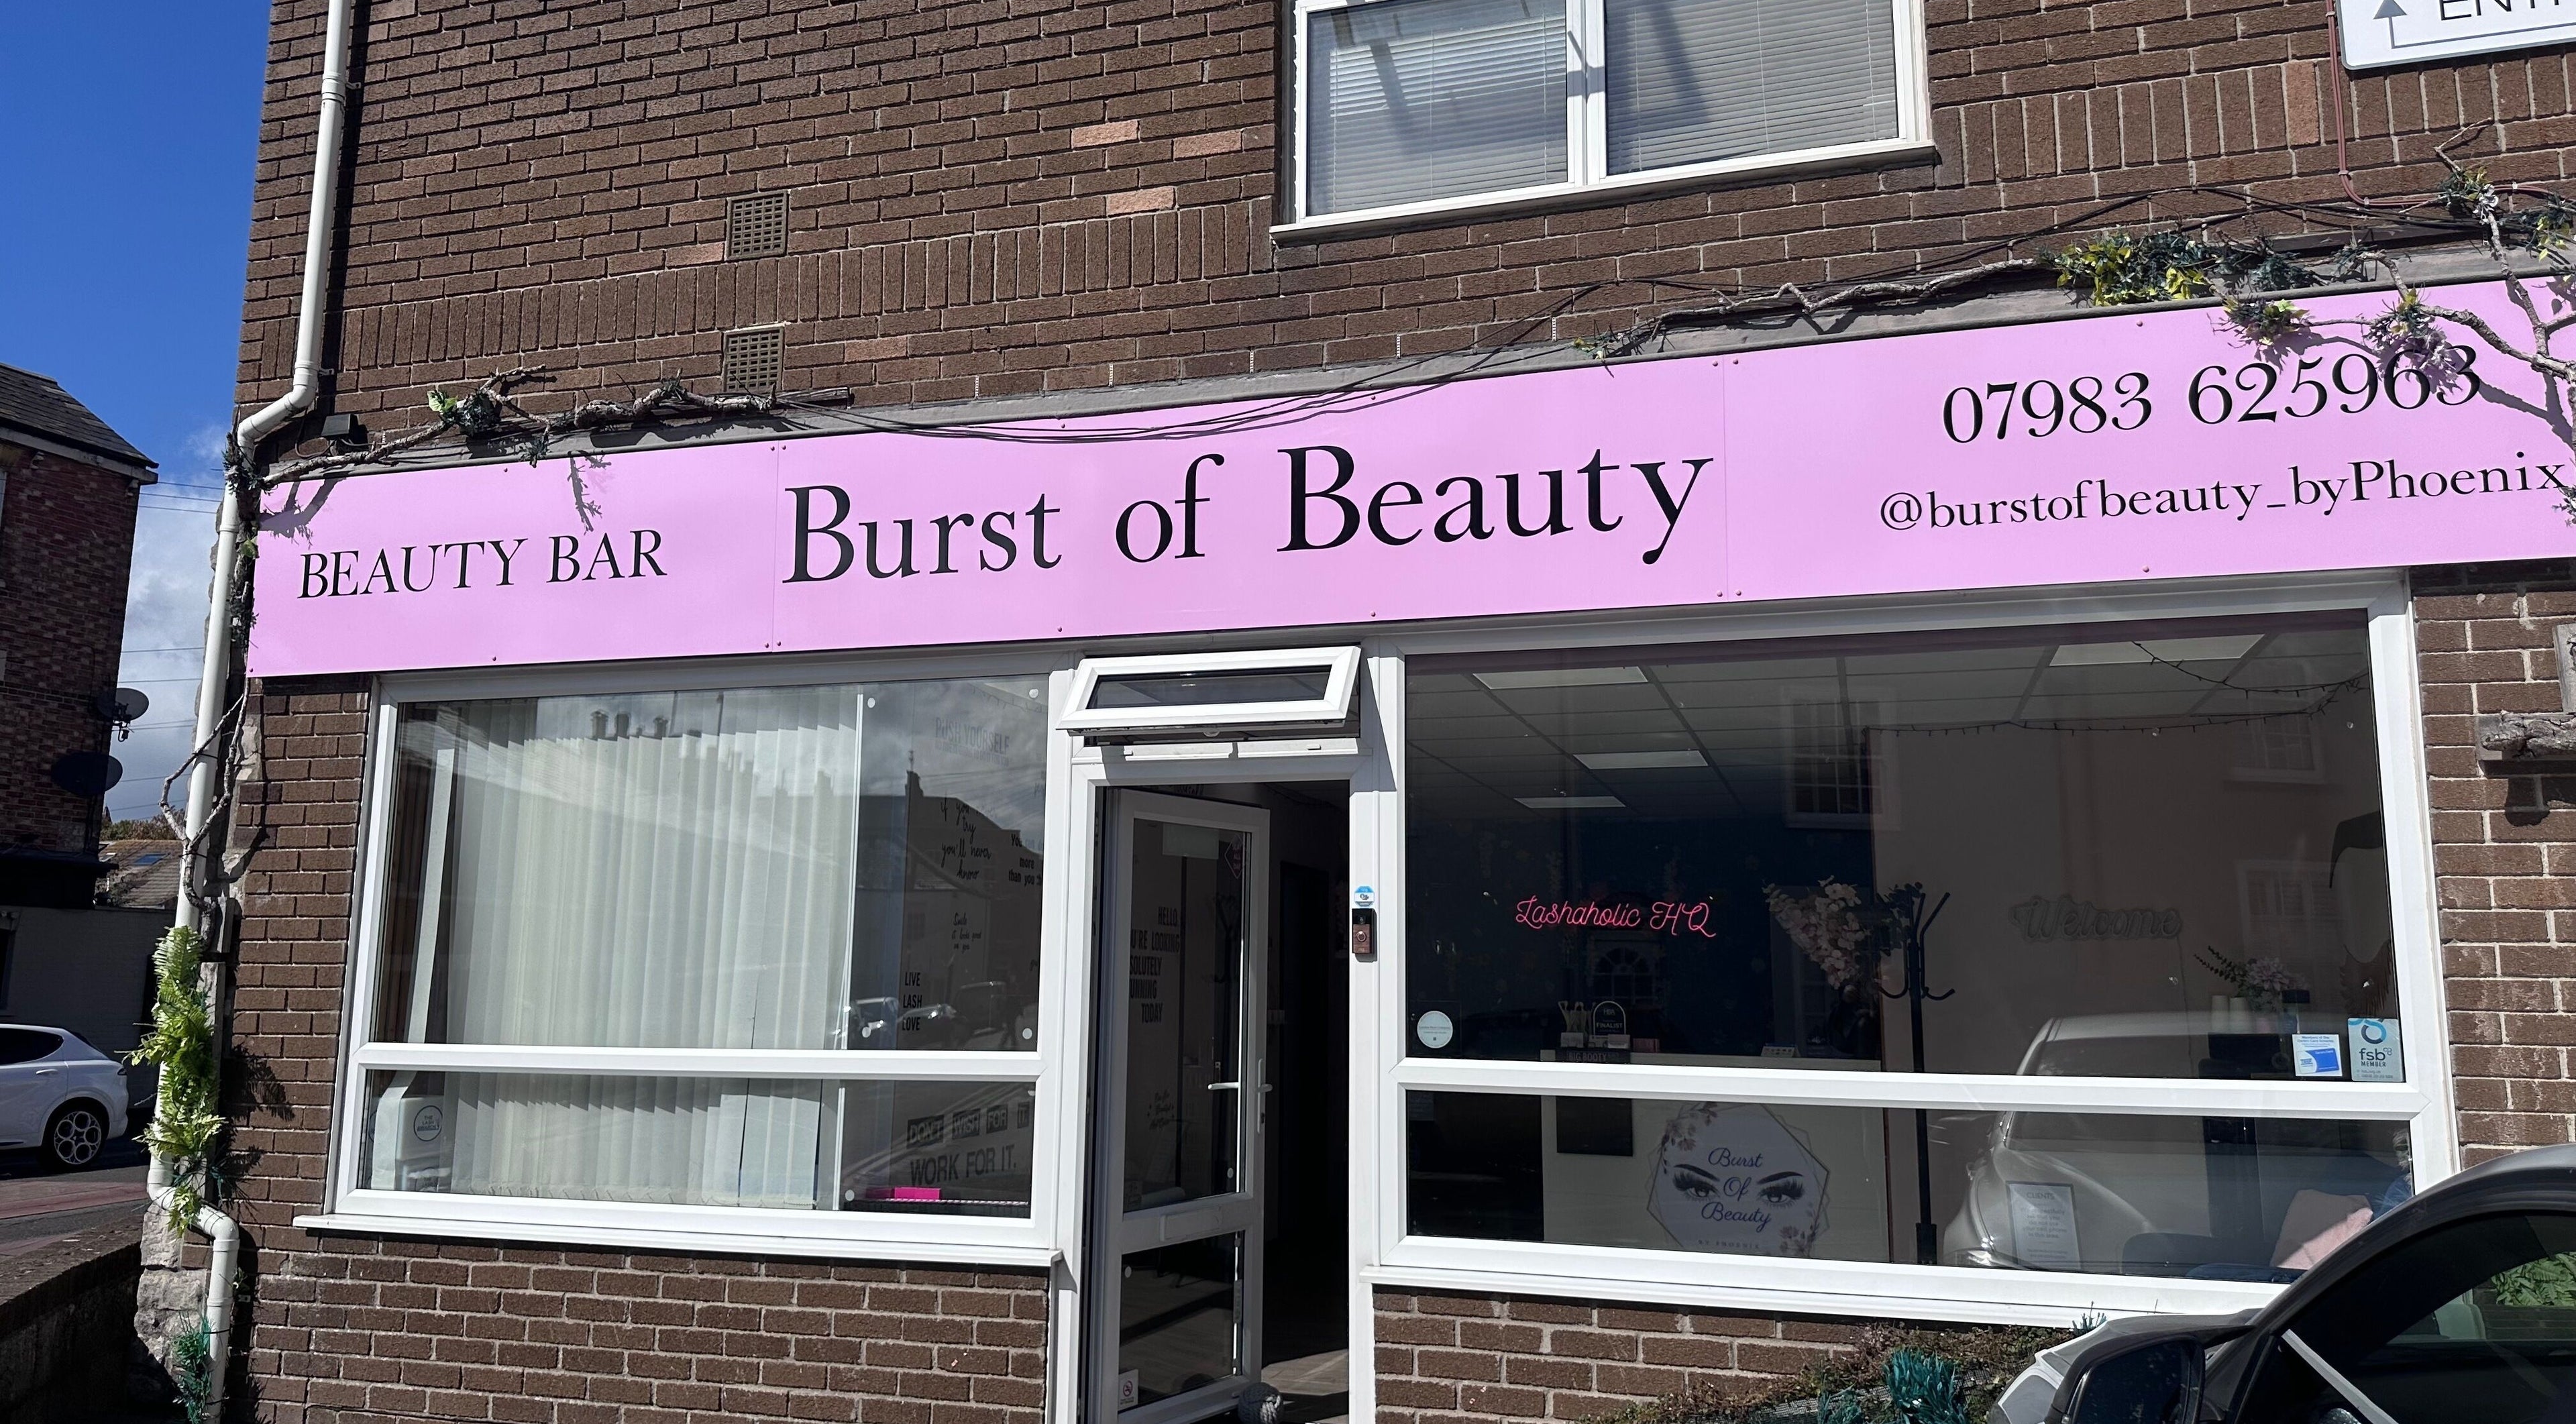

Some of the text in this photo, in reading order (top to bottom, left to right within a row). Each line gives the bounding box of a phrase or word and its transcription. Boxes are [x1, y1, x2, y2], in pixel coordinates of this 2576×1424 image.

[1942, 344, 2481, 444] 07983 625963
[1880, 451, 2569, 531] @burstofbeauty_byPhoenix
[781, 444, 1714, 584] Burst of Beauty
[297, 529, 667, 599] BEAUTY BAR
[1515, 894, 1717, 938] Lashaholic HQ
[2010, 895, 2181, 942] Welcome
[1131, 930, 1148, 950] U'RE
[1130, 955, 1163, 977] SOLUTELY
[904, 971, 921, 987] LIVE
[902, 993, 923, 1009] LASH
[902, 1016, 921, 1031] LOVE
[1141, 1002, 1163, 1024] TODAY
[1596, 1022, 1623, 1032] FINALIST
[2359, 1048, 2385, 1061] fsb
[987, 1109, 1007, 1130] FOR
[910, 1144, 1017, 1187] WORK FOR IT.
[1707, 1146, 1764, 1168] Burst
[1722, 1175, 1752, 1202] Of
[1701, 1201, 1772, 1234] Beauty
